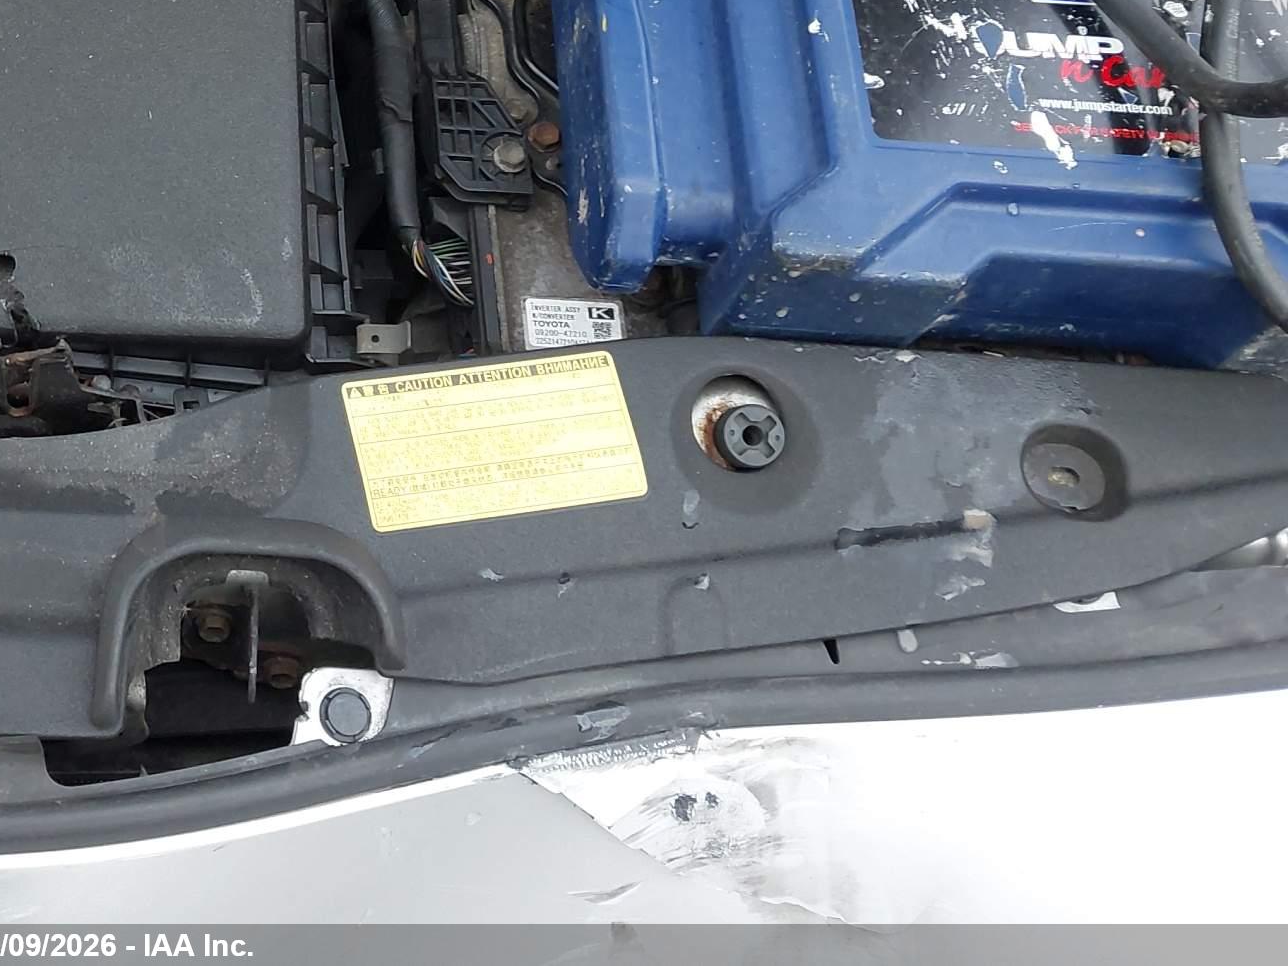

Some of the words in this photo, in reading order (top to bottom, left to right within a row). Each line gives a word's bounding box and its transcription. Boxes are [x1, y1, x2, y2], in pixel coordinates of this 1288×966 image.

[1037, 97, 1174, 117] www.jumpstarter.com
[533, 320, 570, 329] TOYOTA
[536, 354, 608, 376] ВНИМАНИЕ
[395, 375, 453, 394] CAUTION
[459, 366, 532, 386] ATTENTION
